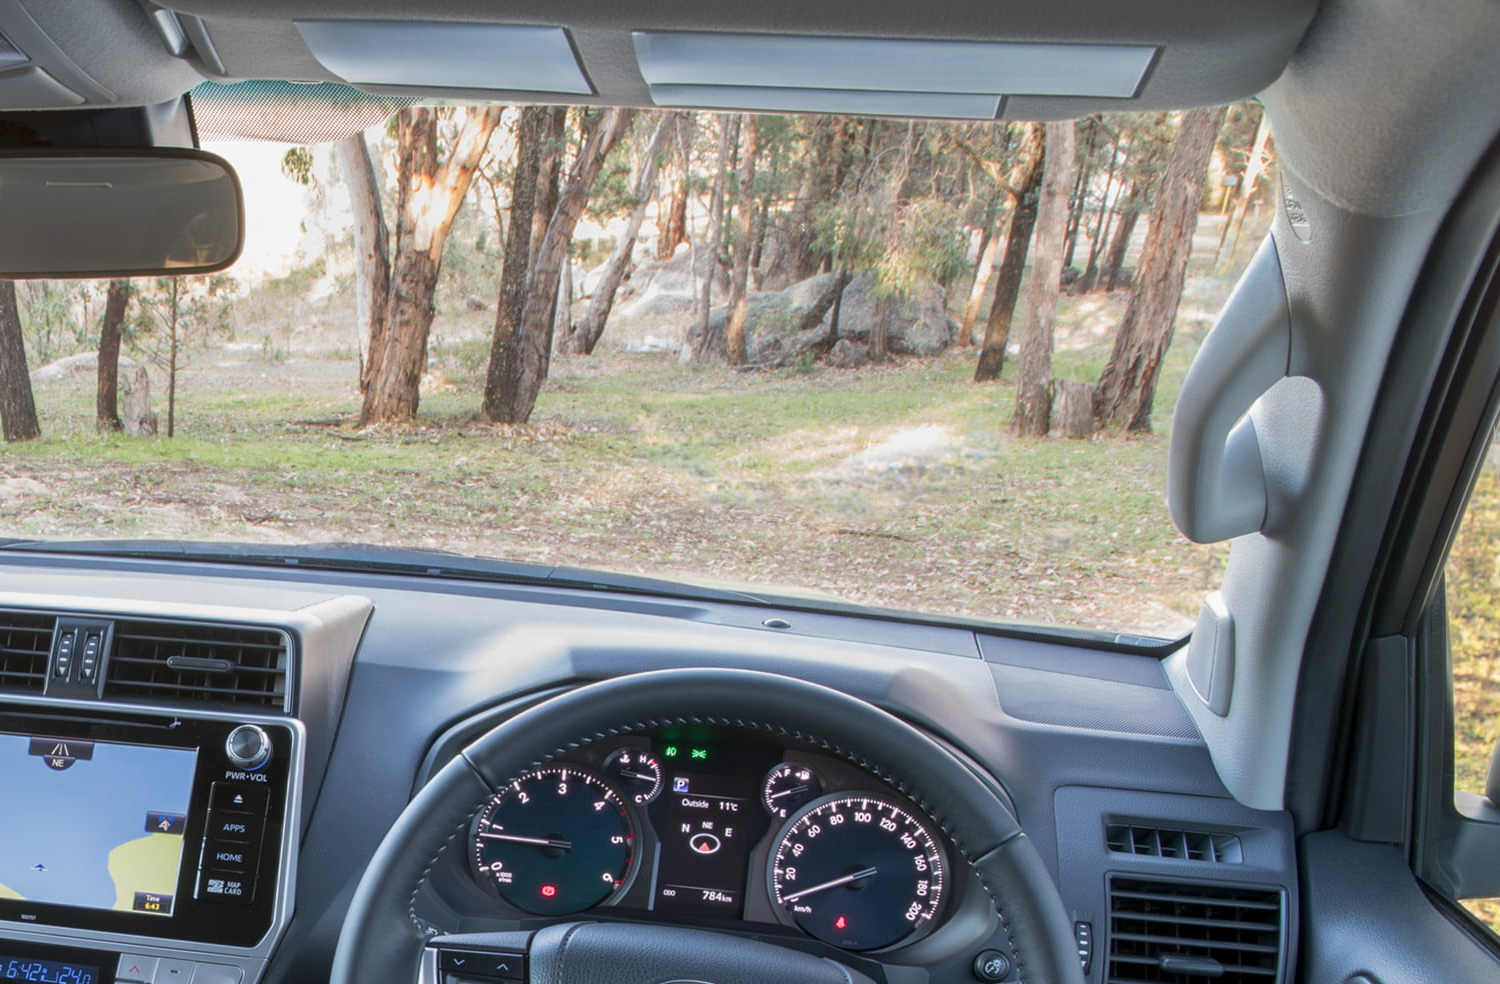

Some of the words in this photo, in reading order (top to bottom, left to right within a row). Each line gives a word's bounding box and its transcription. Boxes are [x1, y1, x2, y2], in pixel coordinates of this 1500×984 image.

[51, 759, 64, 768] NE
[639, 754, 647, 763] H
[784, 769, 791, 777] F
[557, 783, 567, 795] 3
[518, 792, 530, 804] 2
[635, 794, 642, 803] C
[681, 798, 709, 809] Outside
[593, 800, 606, 811] 4
[780, 809, 787, 818] E
[854, 812, 872, 823] 100
[829, 814, 844, 826] 80
[879, 818, 897, 833] 120
[223, 823, 246, 833] APPS
[492, 823, 504, 831] 1
[681, 823, 691, 833] N
[702, 821, 713, 830] NE
[724, 828, 733, 837] E
[807, 824, 821, 838] 60
[611, 835, 624, 845] 5
[900, 832, 917, 850] 140
[792, 843, 805, 858] 40
[216, 852, 243, 863] HOME
[913, 854, 928, 872] 160
[491, 861, 503, 871] 0
[602, 872, 614, 883] 6
[785, 867, 797, 881] 20
[224, 887, 242, 896] CARD
[916, 879, 929, 897] 180
[145, 894, 160, 902] Time
[702, 890, 721, 901] 784
[144, 902, 160, 911] 6:43
[794, 904, 812, 914] km/h
[905, 901, 922, 921] 200
[6, 960, 42, 981] 6:42
